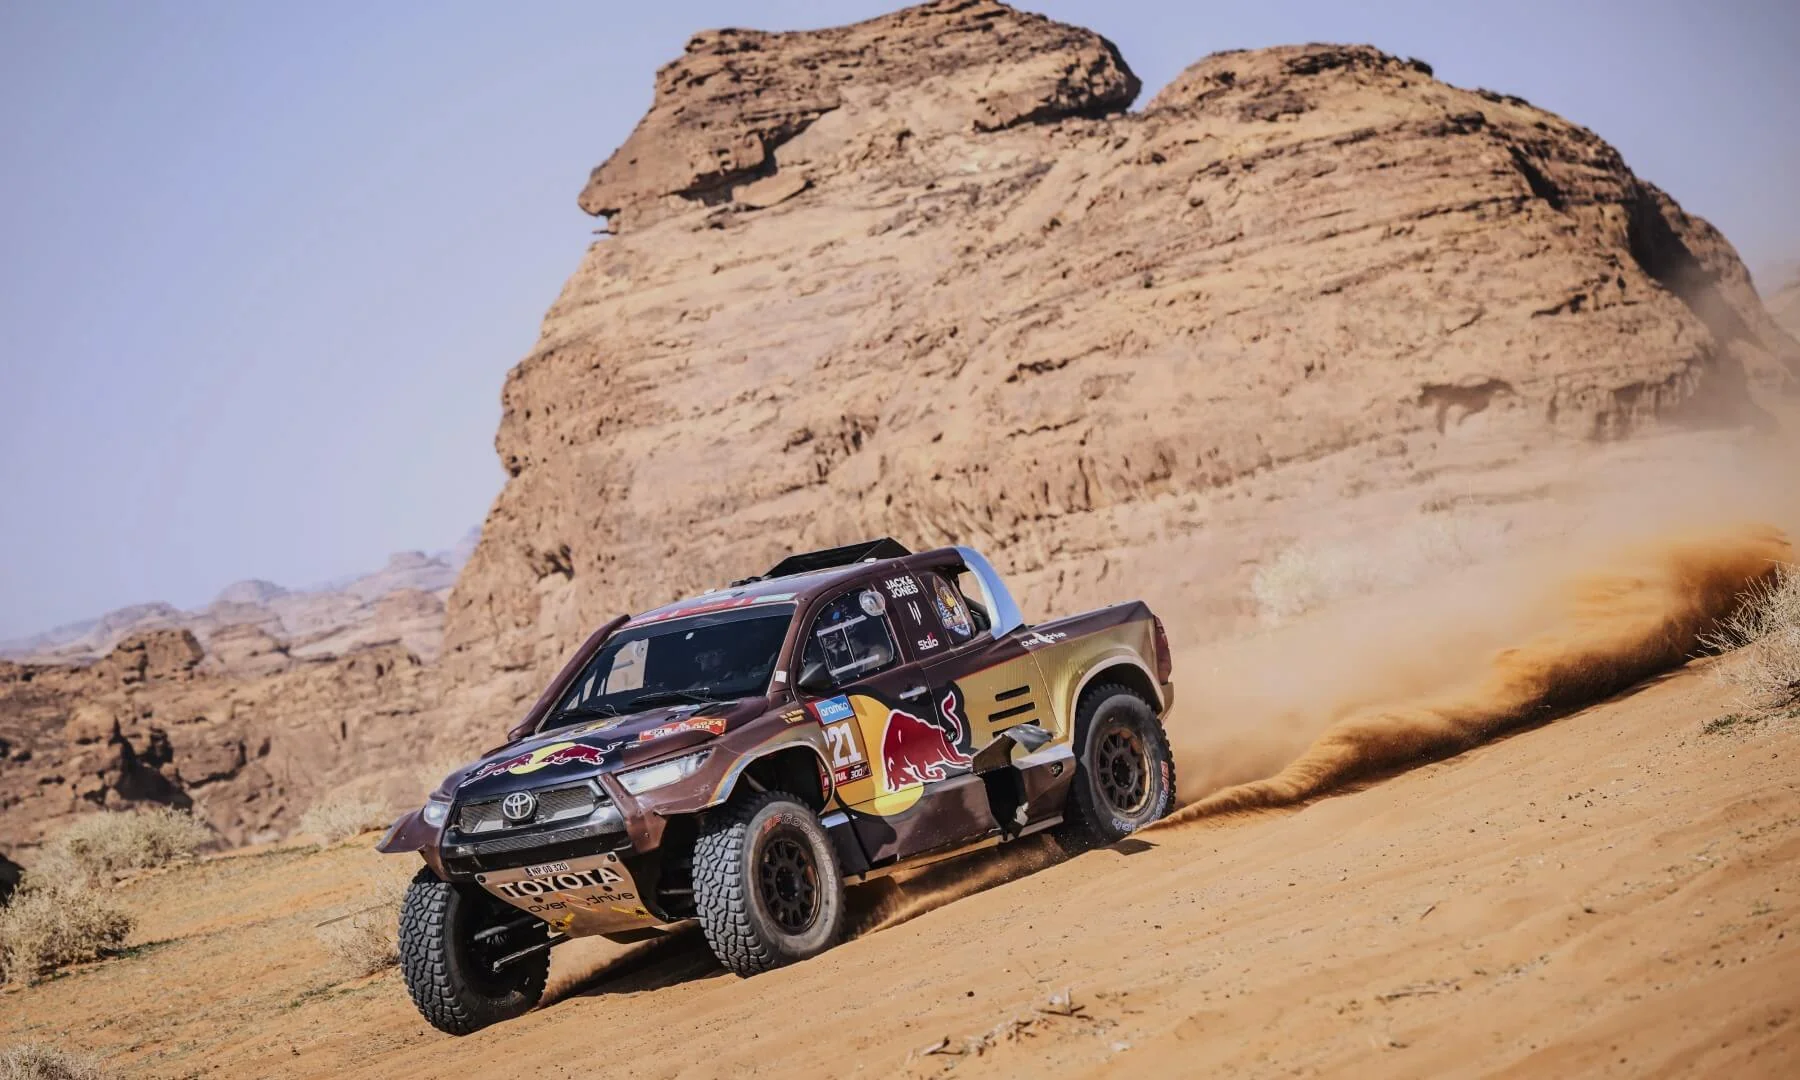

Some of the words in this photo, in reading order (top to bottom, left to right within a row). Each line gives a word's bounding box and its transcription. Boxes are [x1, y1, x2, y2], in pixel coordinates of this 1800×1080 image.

[885, 576, 914, 590] JACK&
[891, 585, 918, 598] JONES
[820, 702, 848, 716] aramco
[496, 867, 624, 898] TOYOTA
